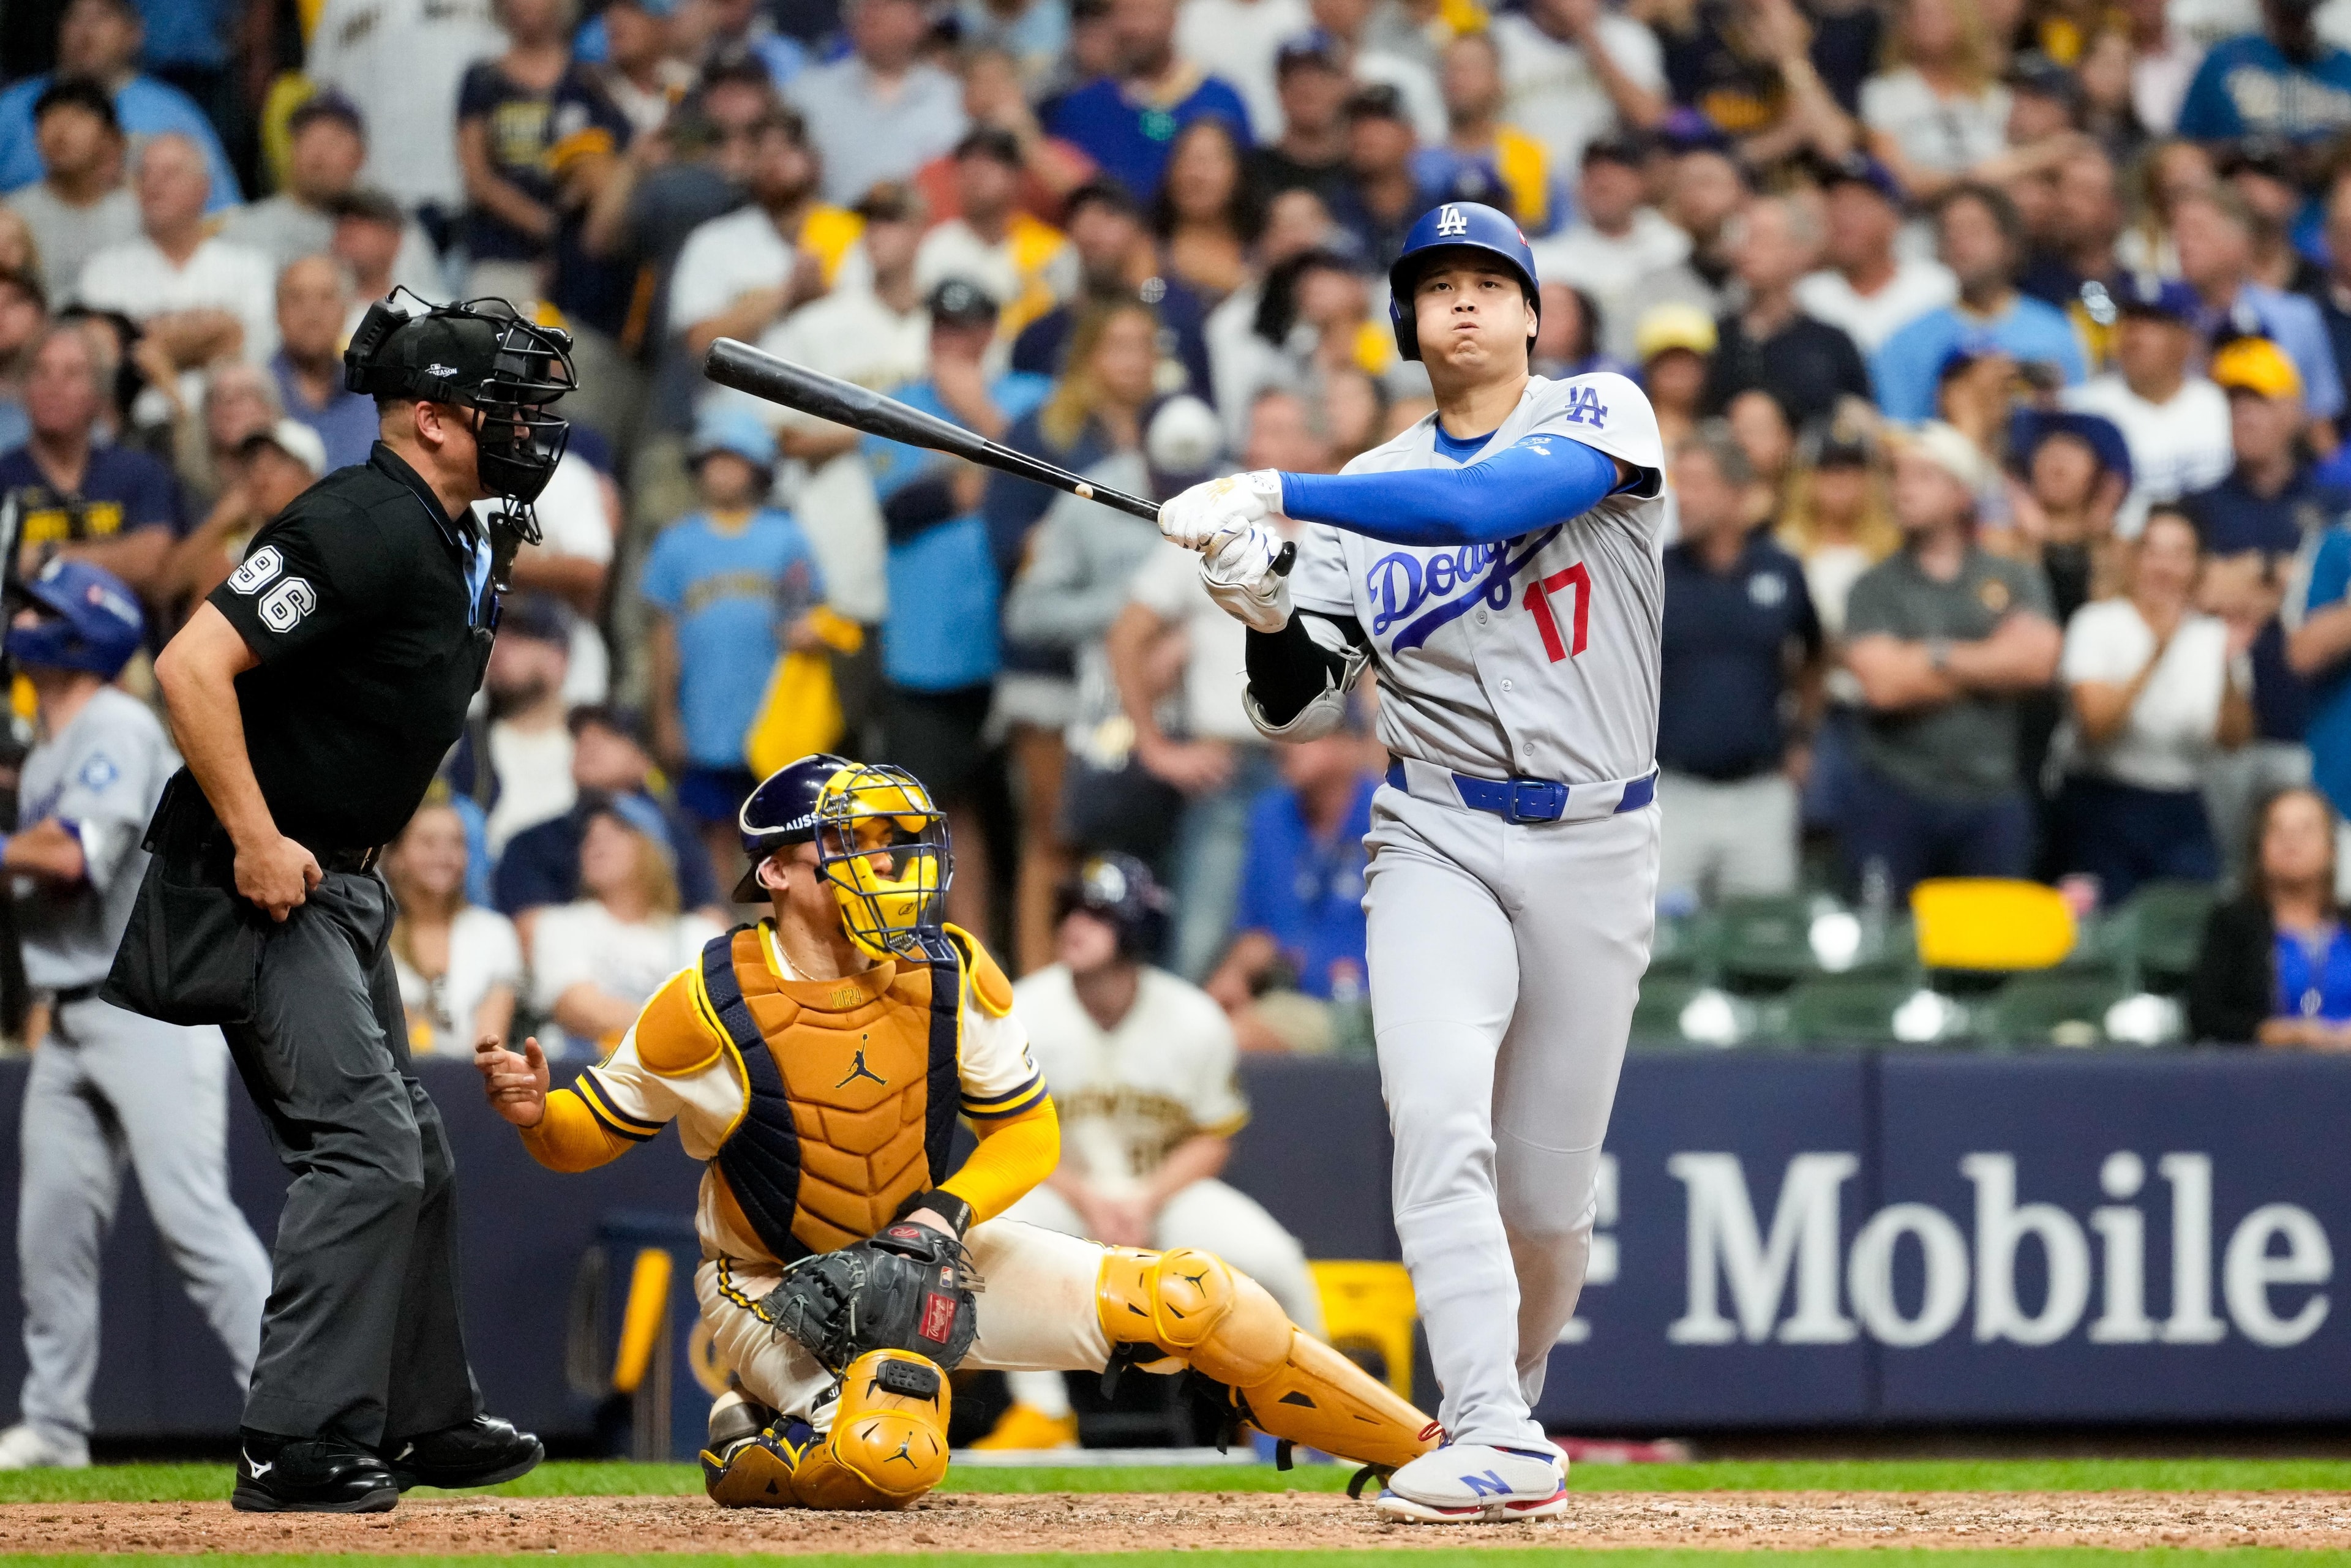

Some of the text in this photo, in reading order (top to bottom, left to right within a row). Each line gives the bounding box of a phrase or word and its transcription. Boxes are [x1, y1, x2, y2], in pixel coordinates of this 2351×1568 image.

[1437, 204, 1467, 237] LA
[1565, 386, 1608, 430] LA
[227, 544, 317, 634] 96
[1367, 533, 1528, 637] Dodg
[1522, 561, 1592, 664] 17
[830, 986, 862, 1009] WC24
[1666, 1149, 2334, 1348] Mobile
